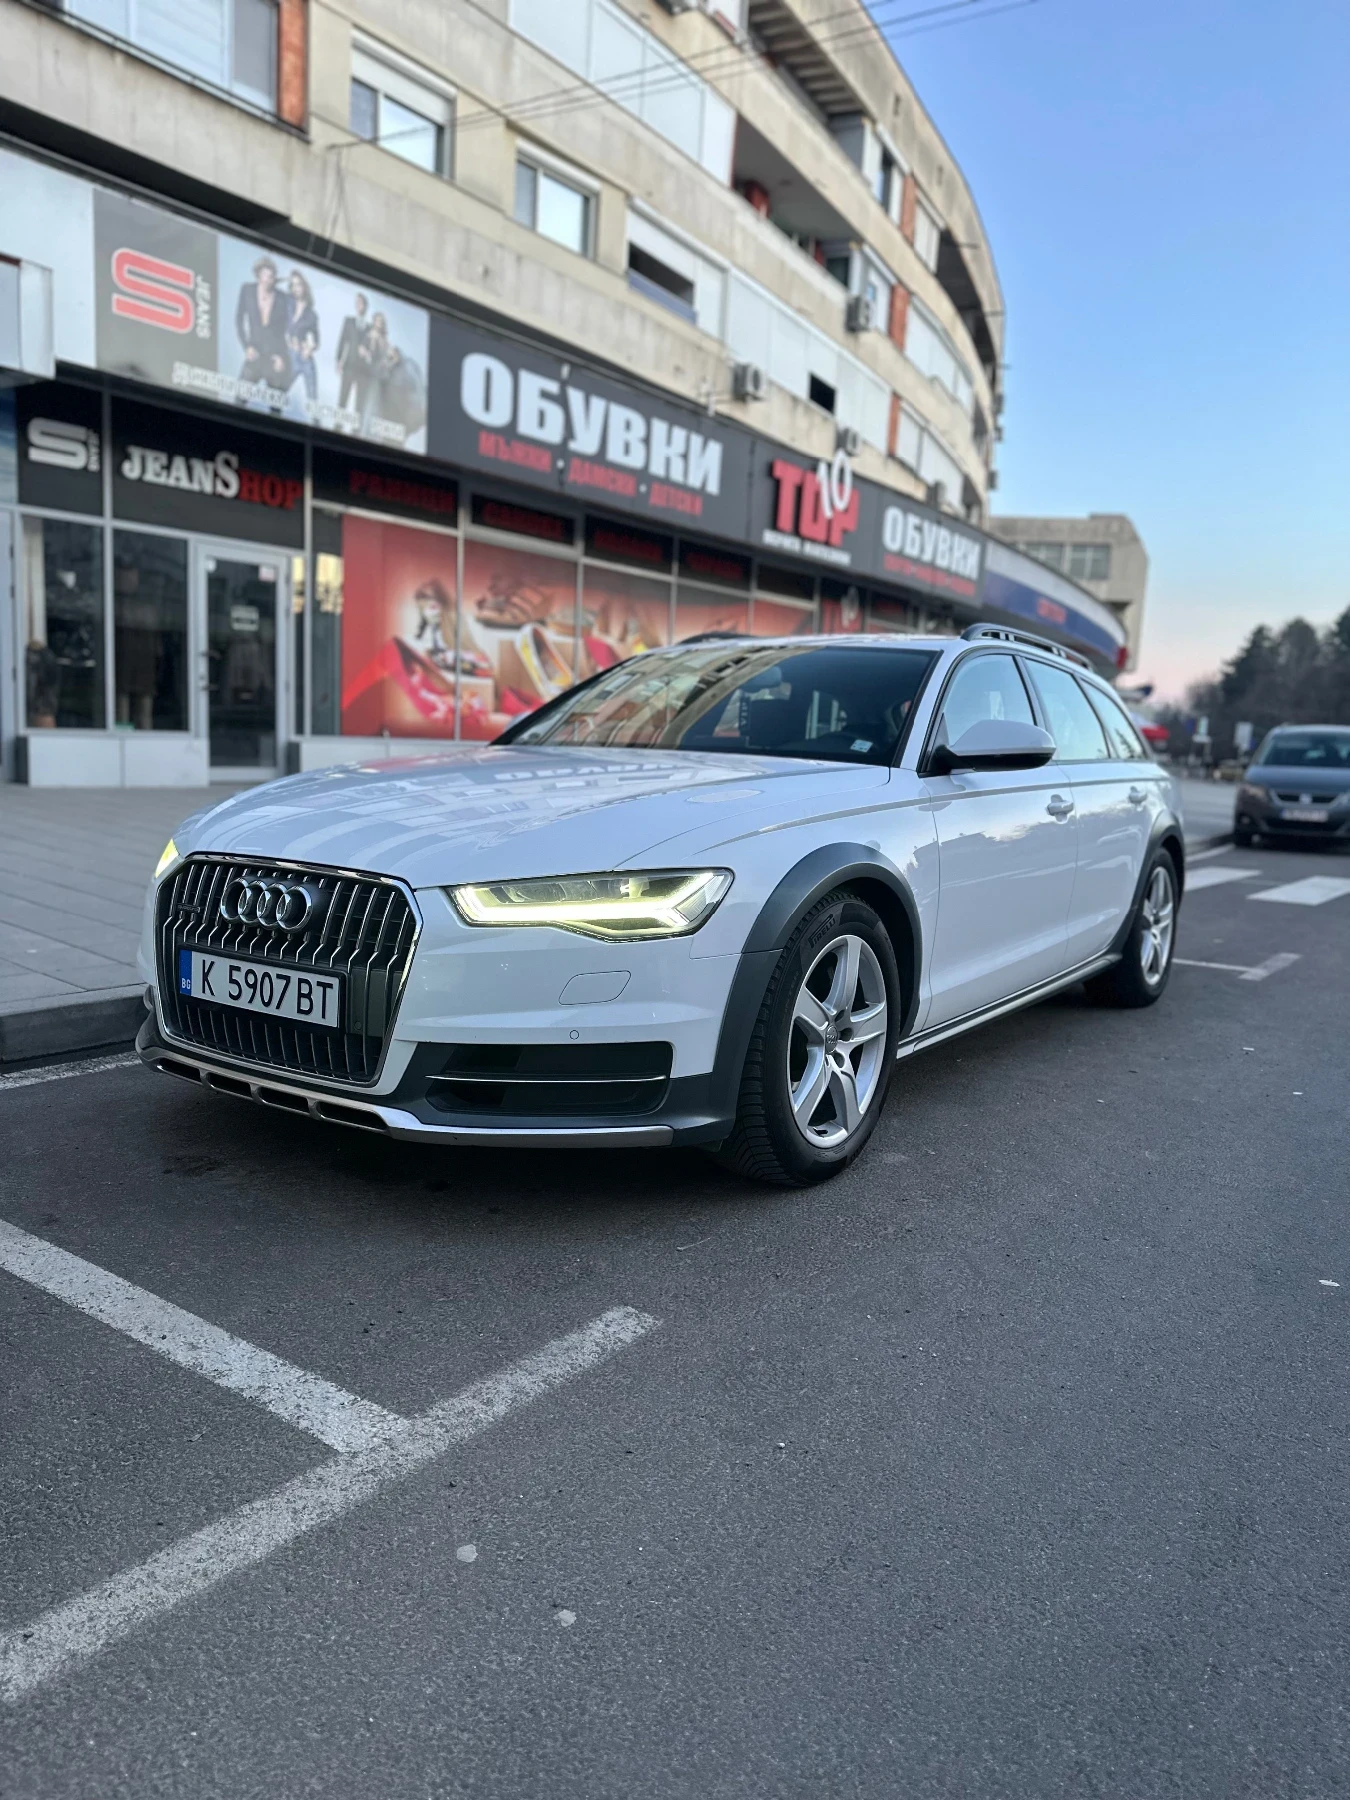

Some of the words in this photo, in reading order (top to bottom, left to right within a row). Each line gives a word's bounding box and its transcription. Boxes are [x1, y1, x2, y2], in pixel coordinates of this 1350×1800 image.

[111, 247, 195, 334] S
[196, 274, 211, 339] JEANS
[28, 417, 88, 470] S
[460, 352, 723, 496] ОБУВКИ
[816, 448, 853, 520] 10
[882, 505, 982, 582] ОБУВКИ
[808, 913, 835, 949] PIRELLI
[181, 977, 191, 990] BG
[201, 959, 216, 996] K
[228, 965, 291, 1010] 5907
[297, 978, 333, 1019] BT
